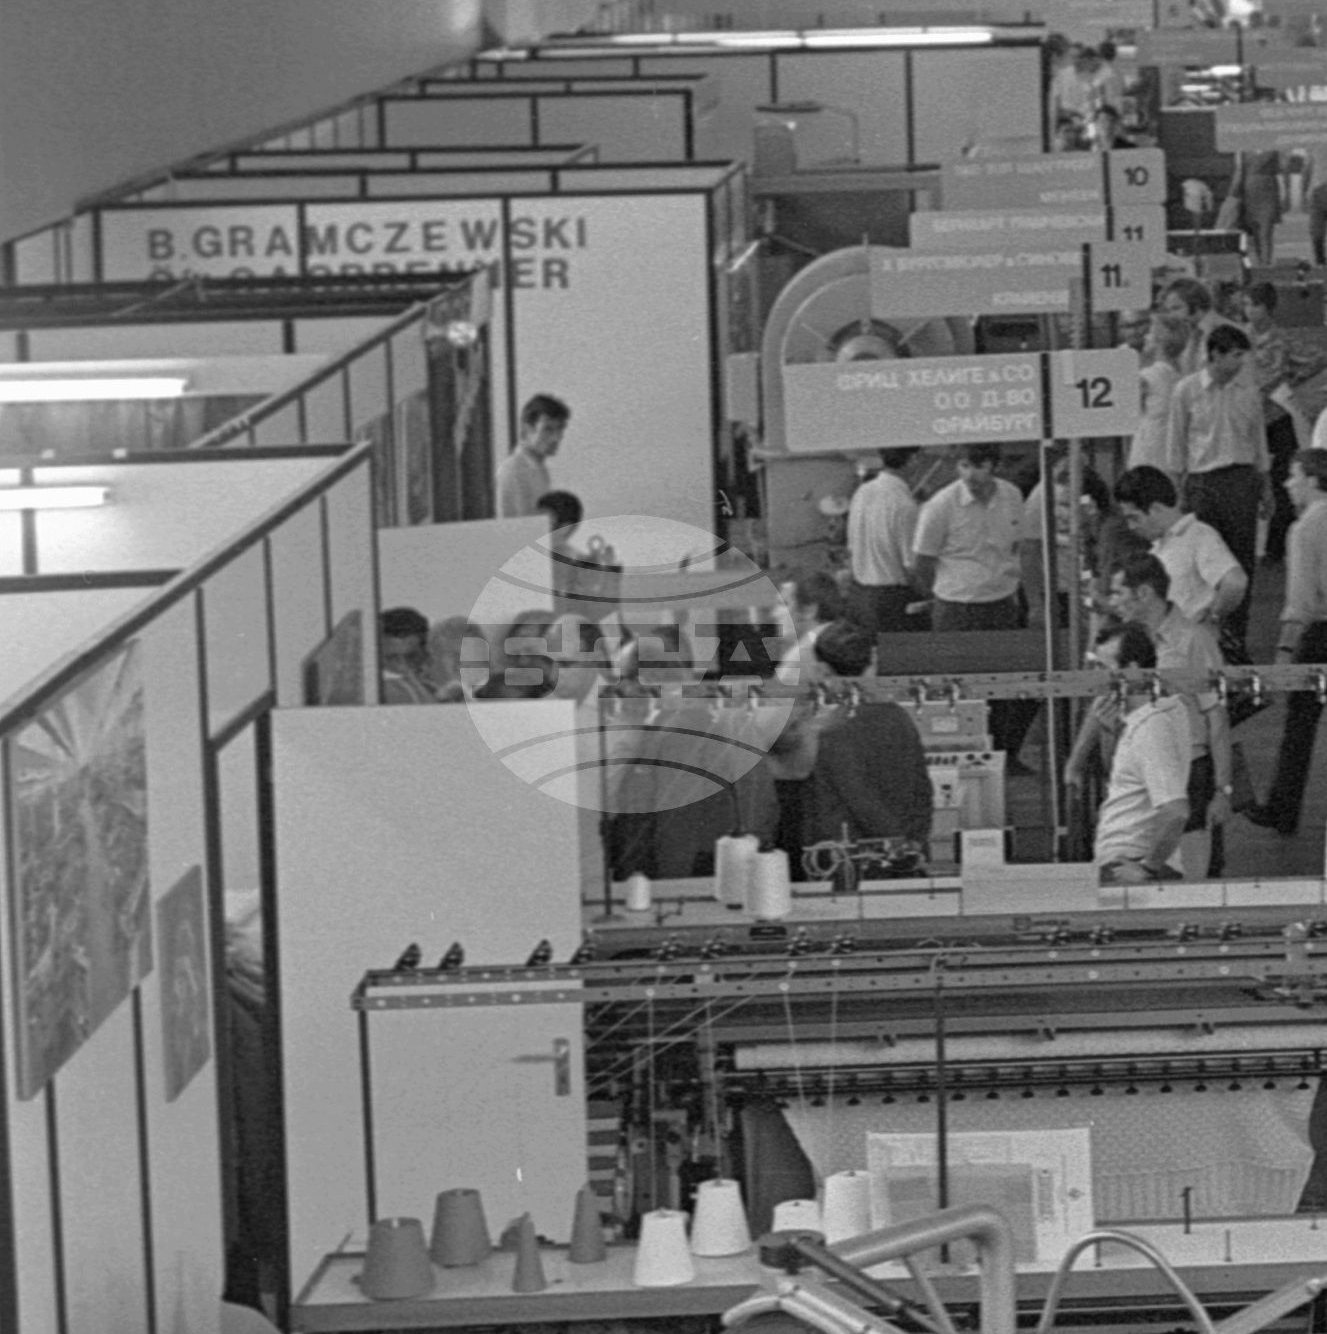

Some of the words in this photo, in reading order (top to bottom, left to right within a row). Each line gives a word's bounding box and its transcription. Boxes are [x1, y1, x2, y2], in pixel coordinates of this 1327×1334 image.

[1124, 166, 1149, 187] 10
[1122, 225, 1144, 241] 11
[1075, 376, 1114, 409] 12
[932, 413, 1038, 435] ФРАЙБУРГ
